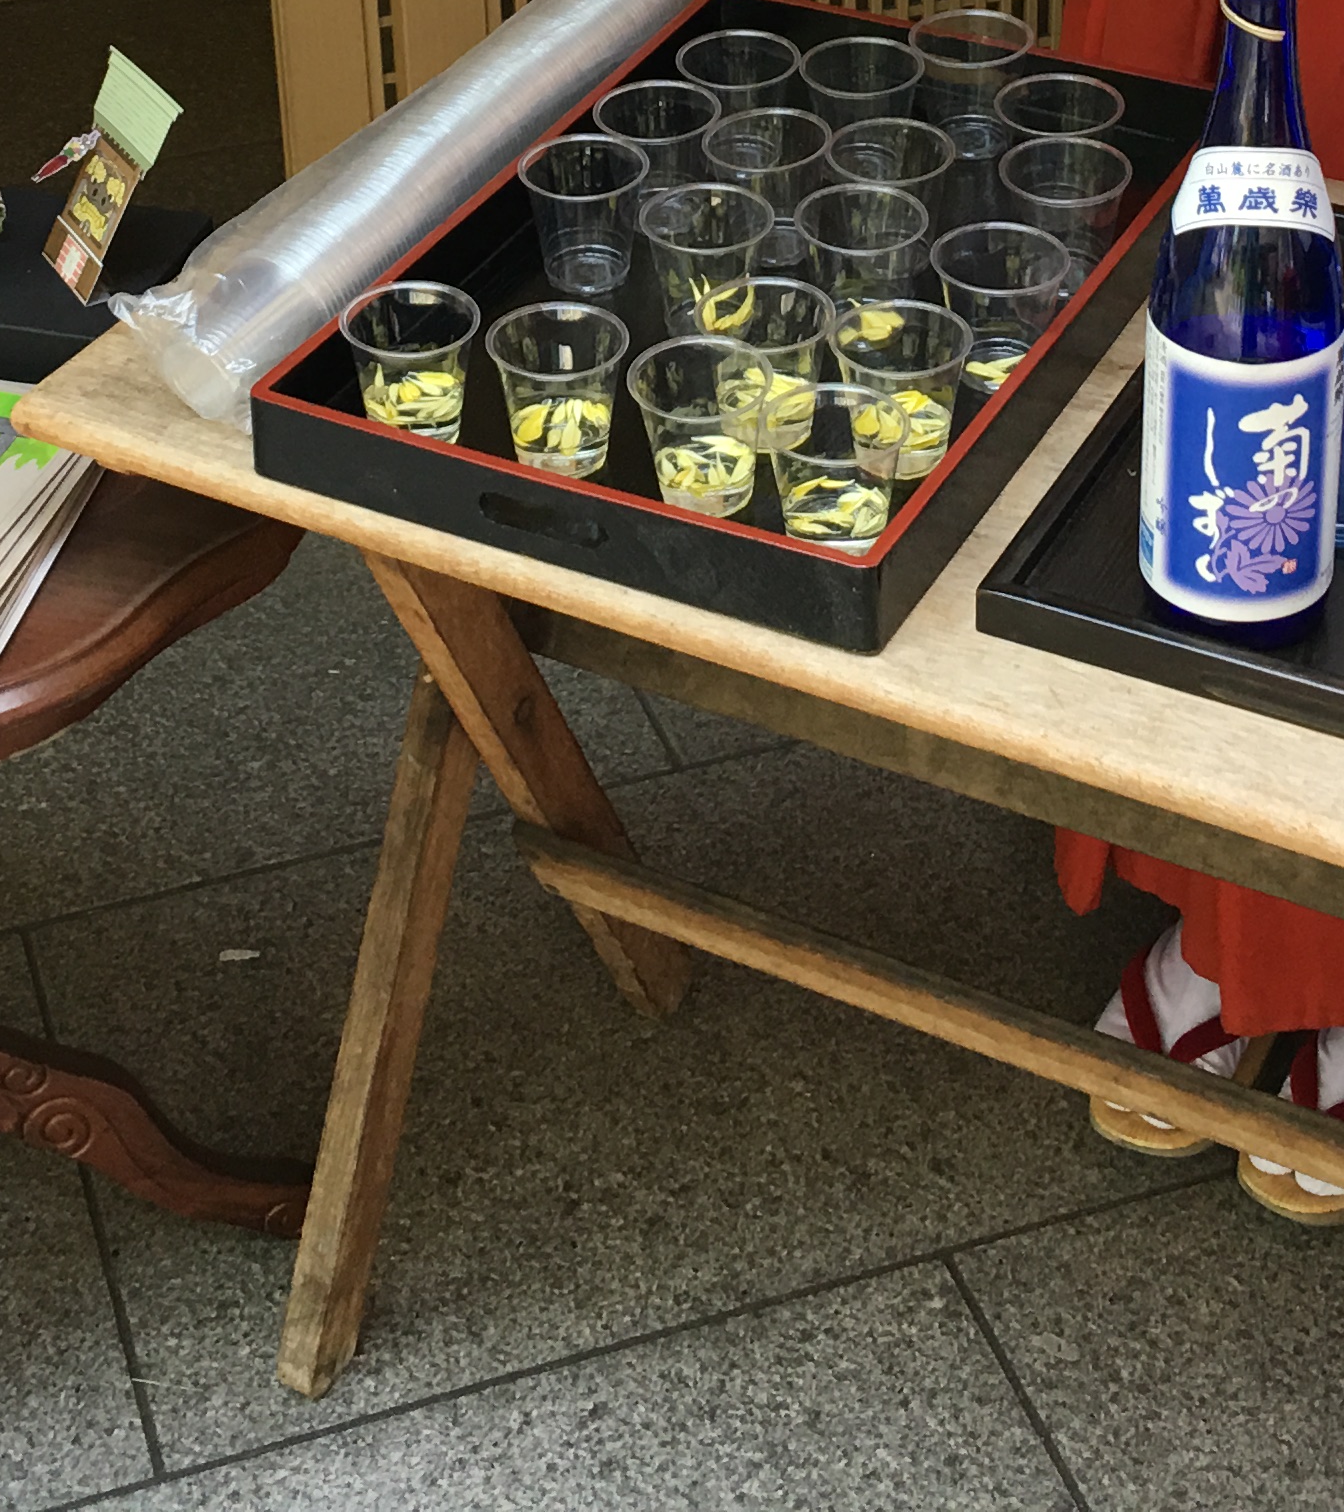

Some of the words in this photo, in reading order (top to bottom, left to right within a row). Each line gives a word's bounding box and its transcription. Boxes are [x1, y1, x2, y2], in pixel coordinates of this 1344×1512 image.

[1205, 161, 1311, 178] 白山麓に名酒あり
